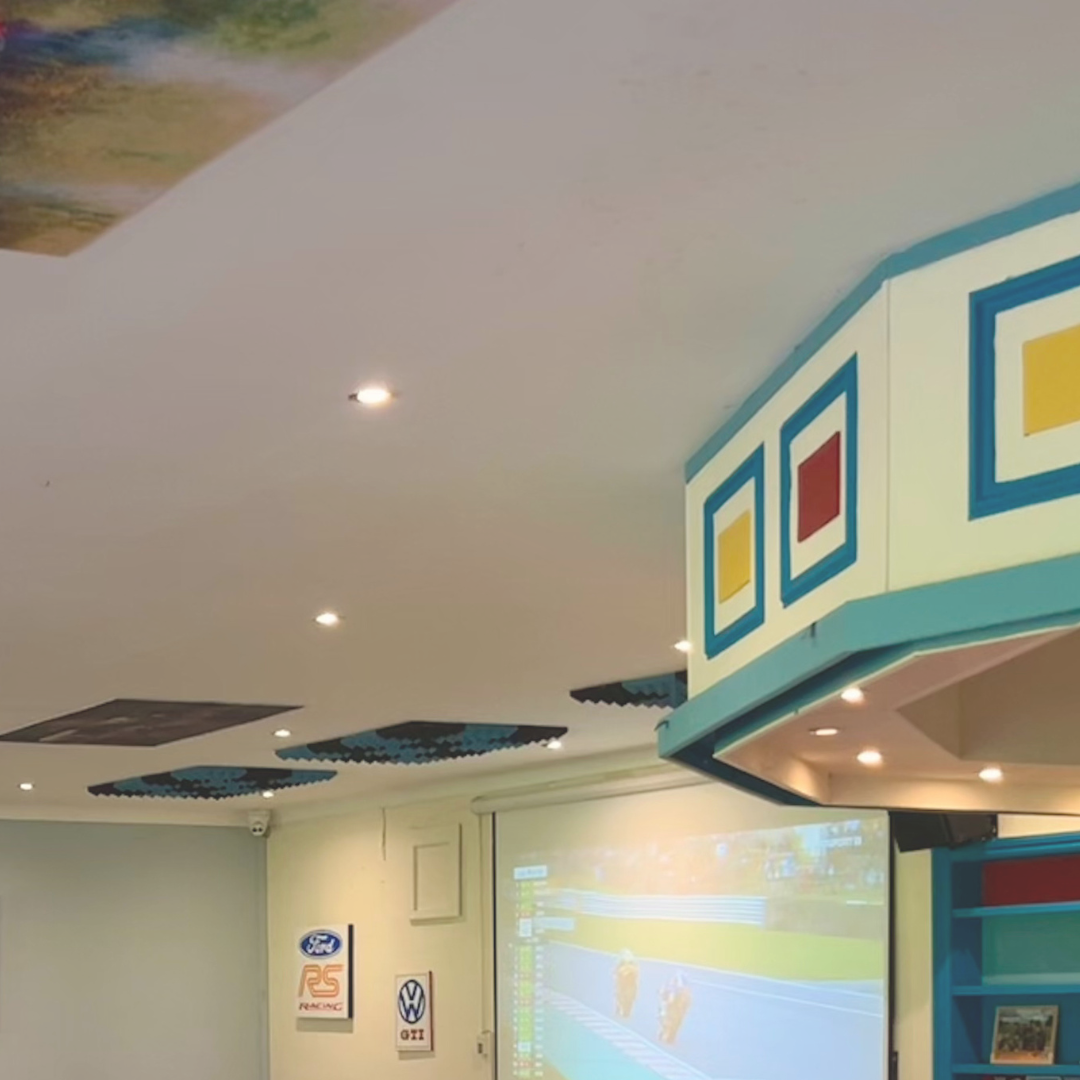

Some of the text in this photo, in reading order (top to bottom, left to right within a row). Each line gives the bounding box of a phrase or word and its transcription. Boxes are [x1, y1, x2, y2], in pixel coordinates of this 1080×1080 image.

[306, 934, 335, 954] Ford
[298, 964, 343, 998] RS
[298, 1002, 343, 1011] RACING
[400, 1029, 425, 1041] GTI
